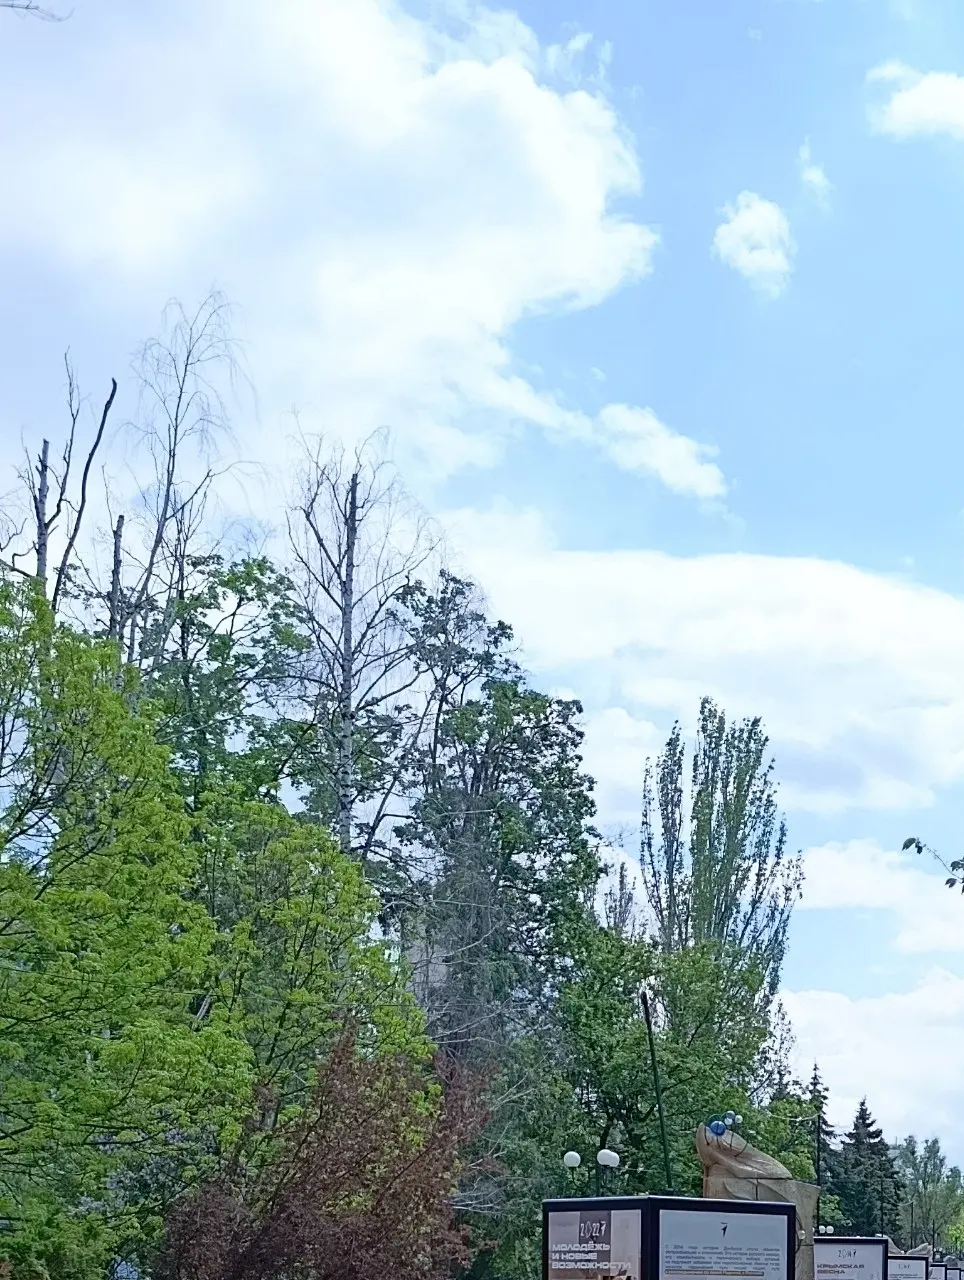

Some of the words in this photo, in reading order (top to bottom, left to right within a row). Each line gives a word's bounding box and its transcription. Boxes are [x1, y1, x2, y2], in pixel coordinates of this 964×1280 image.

[552, 1241, 610, 1251] МОЛОДЁЖЬ
[552, 1252, 560, 1260] И
[561, 1252, 597, 1260] НОВЫЕ
[552, 1261, 631, 1269] ВОЗМОЖНОСТИ
